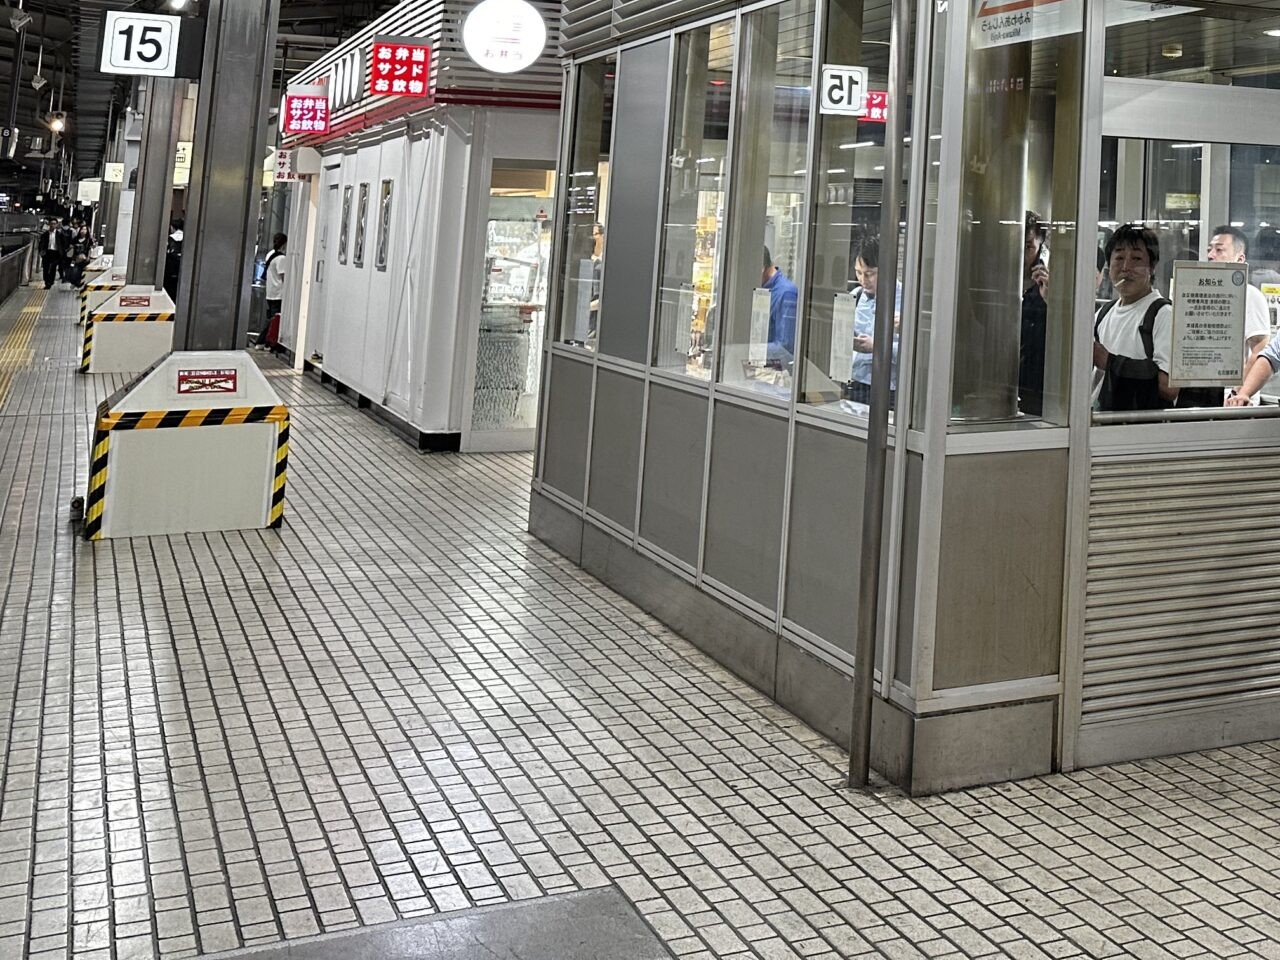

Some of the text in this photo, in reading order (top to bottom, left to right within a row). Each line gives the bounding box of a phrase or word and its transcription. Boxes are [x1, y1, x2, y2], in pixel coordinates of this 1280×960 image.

[118, 23, 164, 64] 15
[376, 46, 426, 62] お弁当
[376, 63, 424, 78] サンド
[374, 78, 424, 94] お飲物
[290, 97, 327, 110] お弁当
[290, 109, 326, 120] サンド
